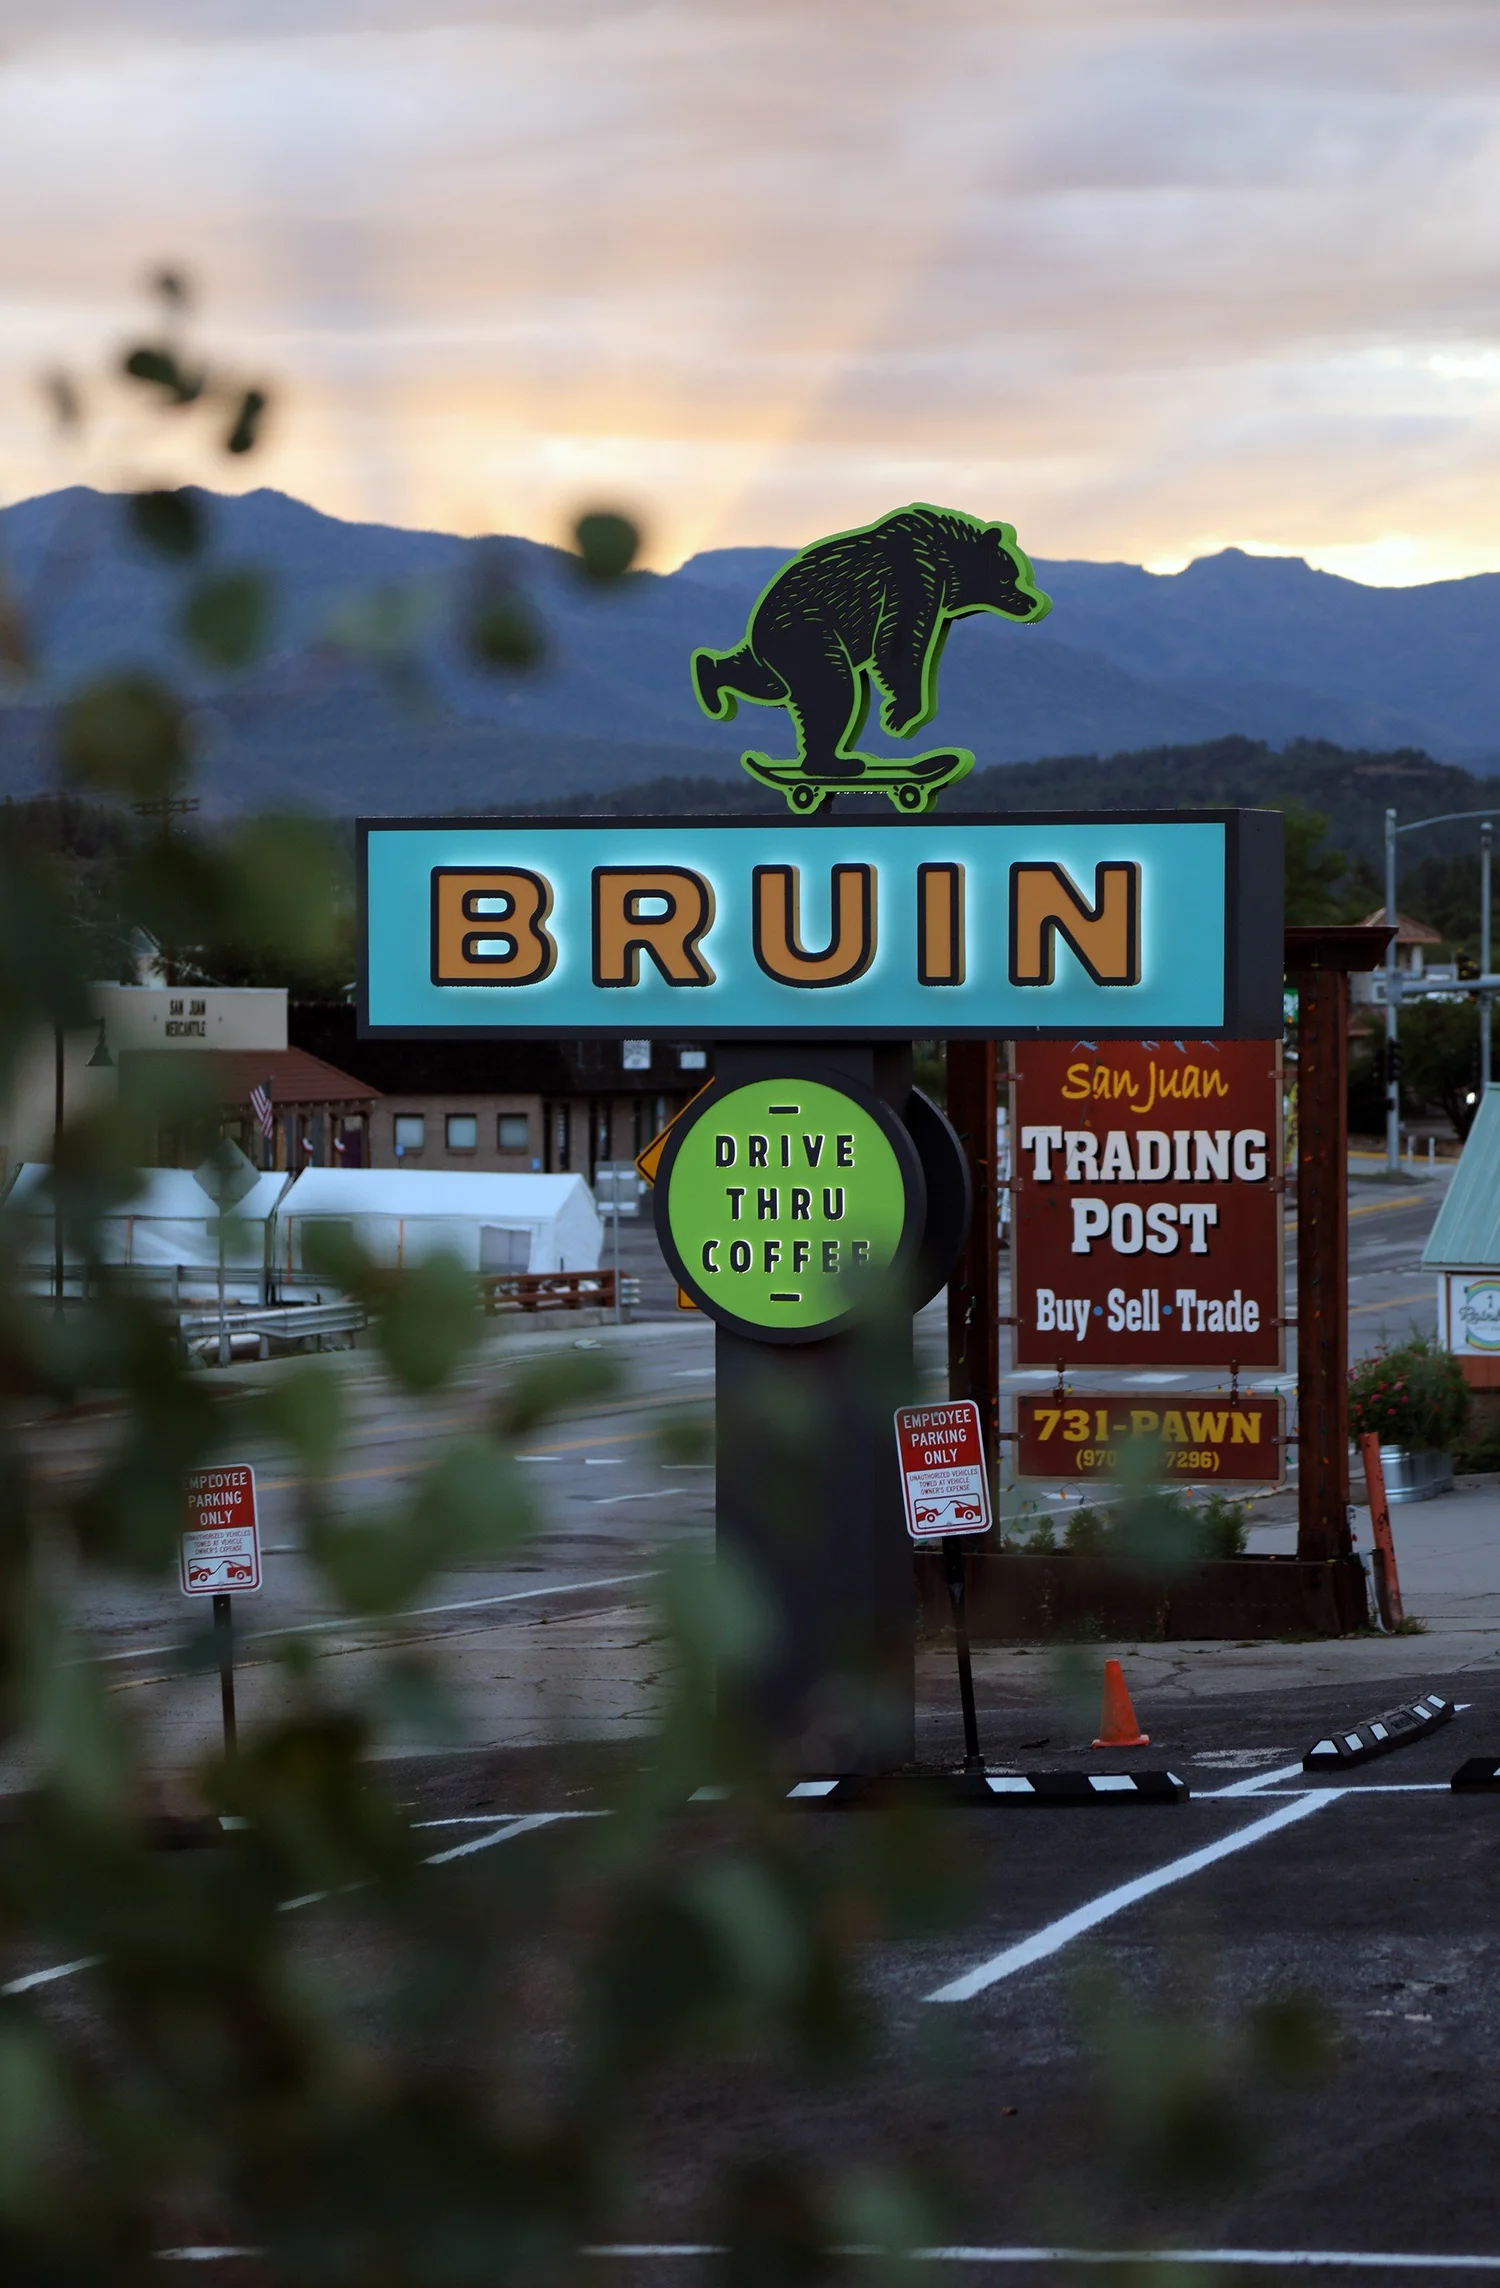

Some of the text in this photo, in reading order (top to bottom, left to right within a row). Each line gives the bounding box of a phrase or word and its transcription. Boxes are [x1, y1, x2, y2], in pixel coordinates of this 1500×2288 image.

[430, 861, 1142, 988] BRUIN
[170, 999, 206, 1016] SAN JUAN
[165, 1020, 206, 1037] MERCANTILE
[1061, 1060, 1229, 1113] San Juan
[715, 1134, 855, 1168] DRIVE
[1021, 1125, 1268, 1182] TRADING
[726, 1187, 845, 1221] THRU
[1071, 1198, 1218, 1254] POST
[1036, 1287, 1260, 1341] Buy Sell Trade
[903, 1408, 972, 1429] EMPLOYEE
[1033, 1409, 1263, 1444] 731-PAWN
[911, 1428, 967, 1447] PARKING
[924, 1448, 958, 1465] ONLY
[909, 1468, 978, 1482] UNAUTHORIZED VEHICLES
[919, 1480, 937, 1488] TOWED
[946, 1476, 970, 1485] VEHICLE
[946, 1484, 970, 1493] EXPENSE
[188, 1491, 242, 1508] PARKING
[199, 1509, 233, 1526] ONLY
